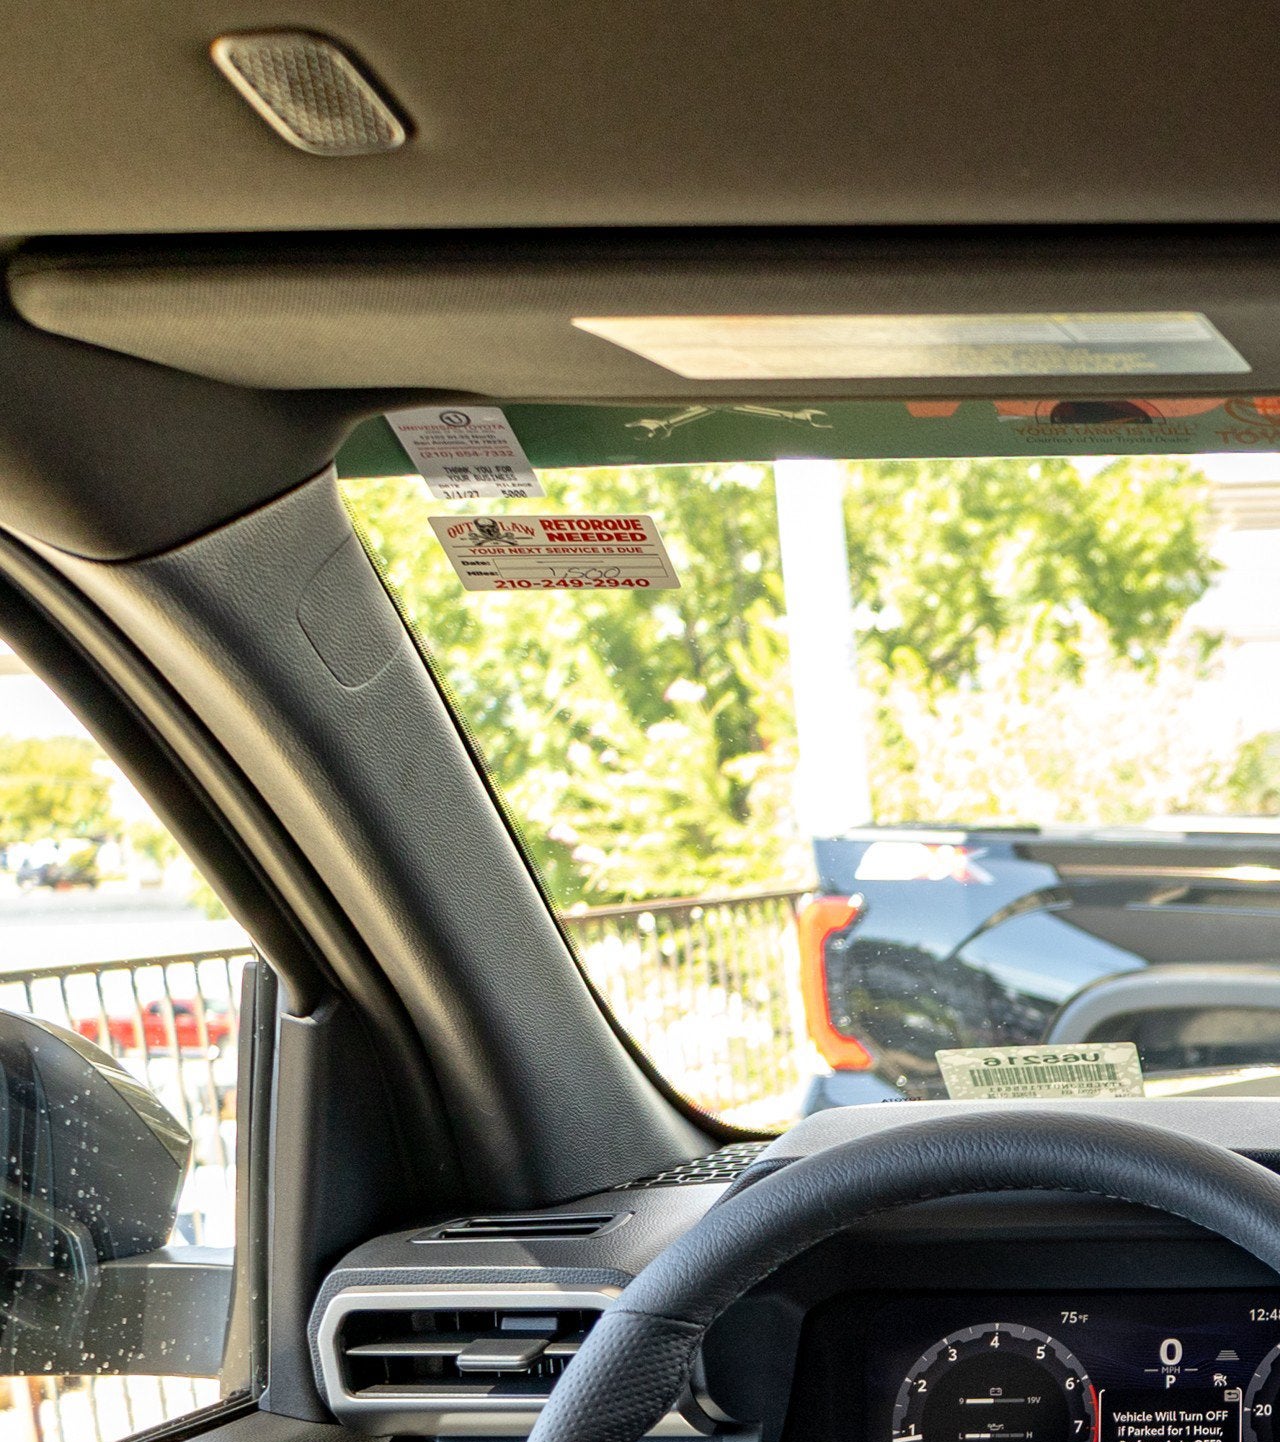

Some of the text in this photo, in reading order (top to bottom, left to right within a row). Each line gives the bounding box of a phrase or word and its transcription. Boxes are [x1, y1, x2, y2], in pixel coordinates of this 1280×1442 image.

[1015, 427, 1070, 437] YOUR
[1073, 426, 1123, 436] TANK
[1148, 425, 1192, 436] FULL
[443, 465, 512, 475] THANK YOU FOR
[449, 473, 518, 482] YOUR BUSINESS
[501, 490, 528, 499] 5000
[447, 521, 536, 539] OUT LAW
[539, 518, 644, 531] RETORQUE
[546, 531, 648, 543] NEEDED
[469, 547, 506, 555] YOUR
[510, 547, 543, 555] NEXT
[617, 546, 644, 554] DUE
[494, 577, 650, 589] 210-249-2940
[1060, 1311, 1089, 1324] 75°F
[990, 1335, 1000, 1349] 4
[948, 1348, 958, 1362] 3
[1036, 1346, 1046, 1360] 5
[1159, 1338, 1183, 1366] 0
[1161, 1366, 1181, 1374] MPH
[917, 1380, 927, 1393] 2
[1065, 1377, 1075, 1391] 6
[1165, 1374, 1177, 1389] P
[1027, 1396, 1042, 1404] 19V
[1112, 1411, 1229, 1423] Vehicle Will Turn OFF
[1255, 1404, 1273, 1417] 20
[1073, 1420, 1084, 1434] 7
[1117, 1425, 1125, 1436] if
[1127, 1425, 1165, 1437] Parked
[1167, 1424, 1183, 1436] for
[1193, 1425, 1223, 1437] Hour,
